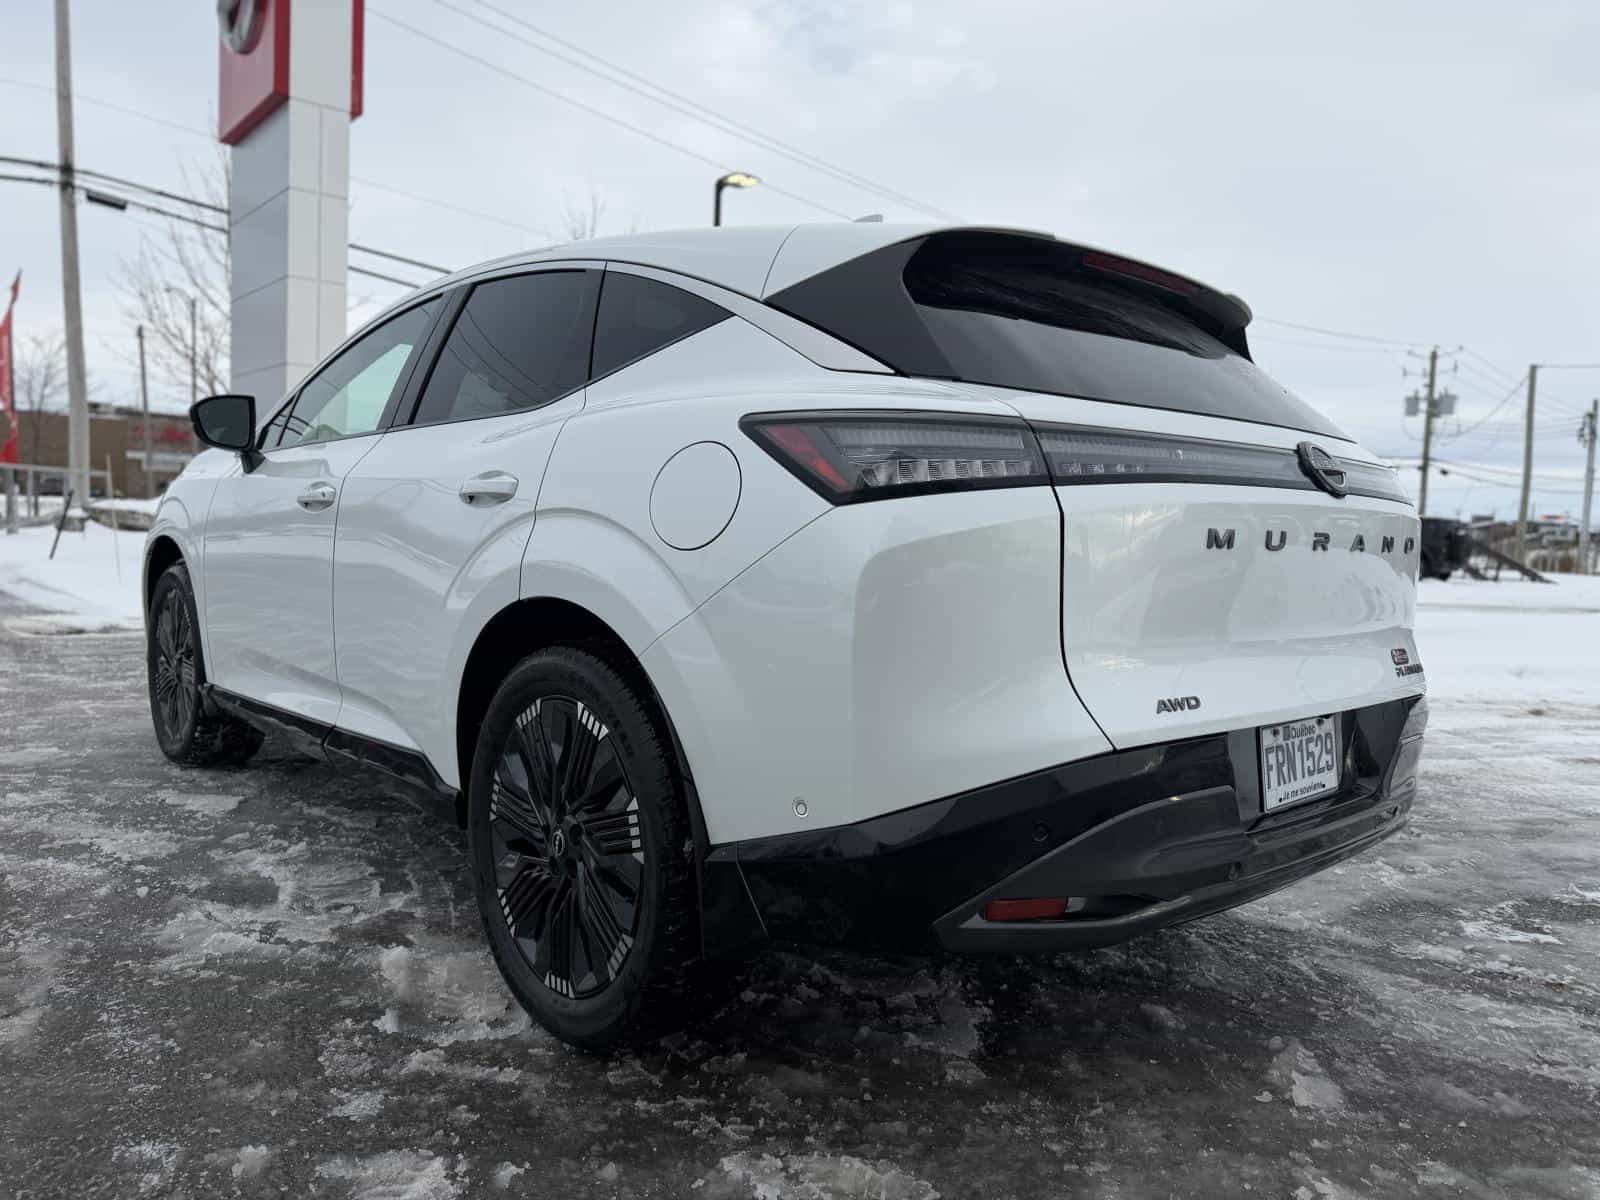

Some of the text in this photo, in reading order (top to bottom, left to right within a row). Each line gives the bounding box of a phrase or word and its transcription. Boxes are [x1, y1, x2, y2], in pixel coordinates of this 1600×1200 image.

[1206, 527, 1415, 554] MURANO
[1156, 696, 1201, 714] AWD
[1265, 732, 1334, 789] FRN1529
